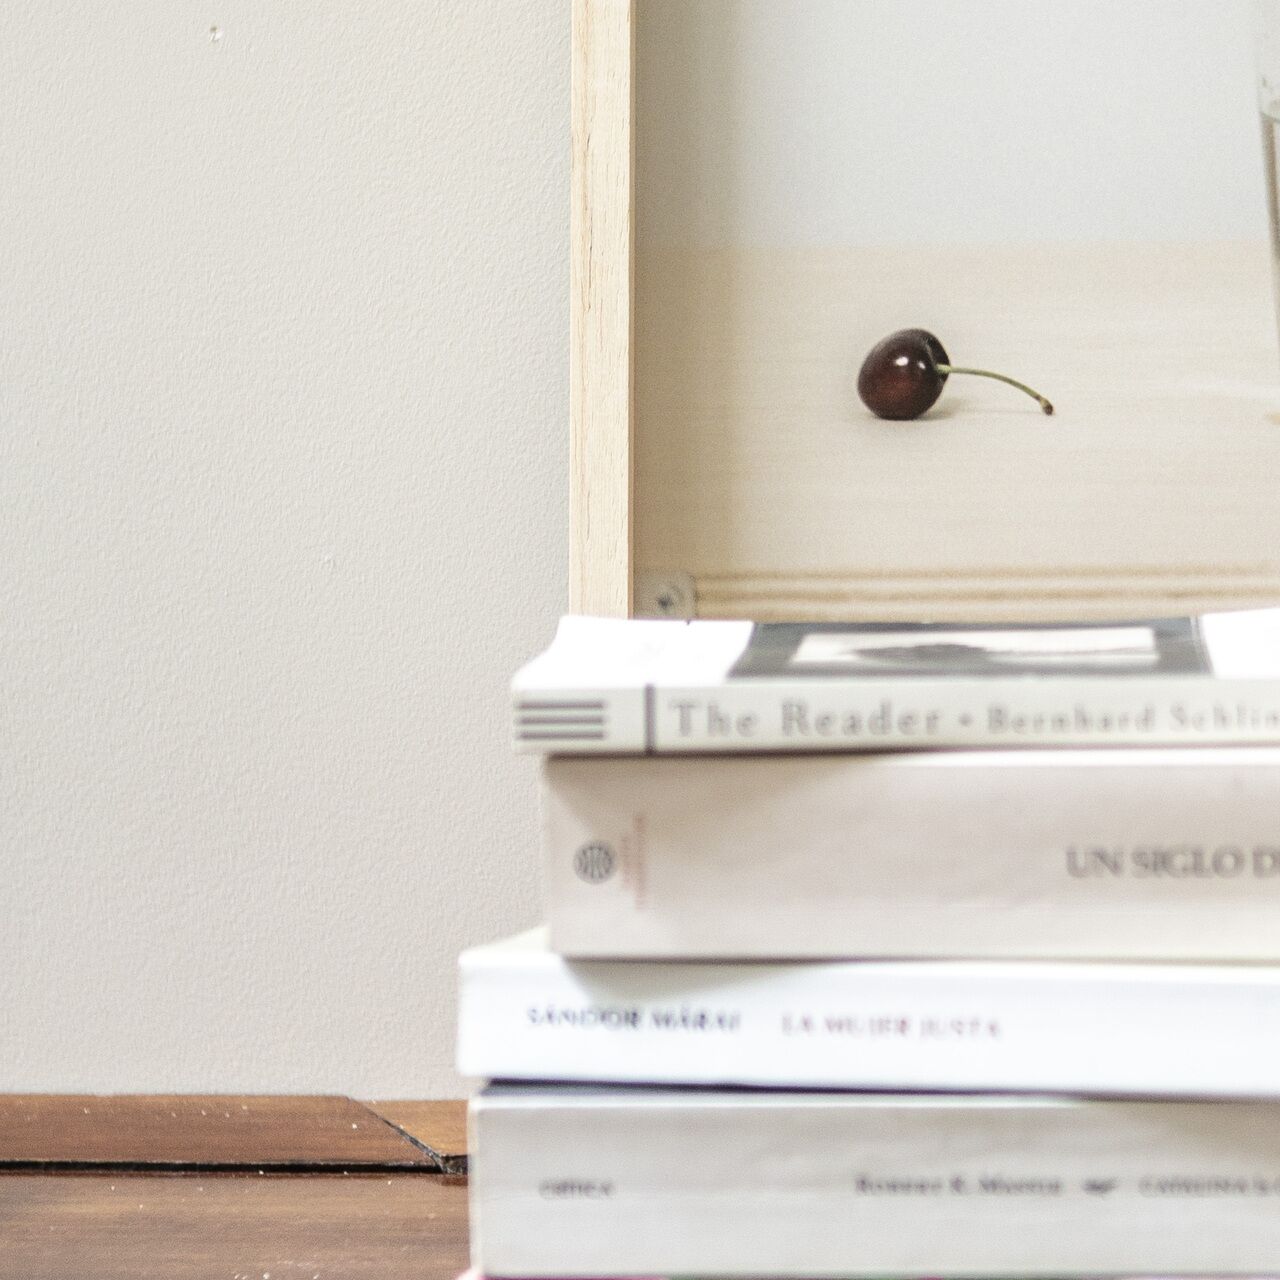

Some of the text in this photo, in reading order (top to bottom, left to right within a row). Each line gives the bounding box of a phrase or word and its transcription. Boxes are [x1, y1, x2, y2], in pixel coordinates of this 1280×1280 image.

[671, 698, 756, 738] The
[780, 697, 940, 736] Reader
[987, 702, 1152, 735] Bernhard
[1064, 845, 1123, 879] UN
[1131, 845, 1246, 879] SIGLO
[781, 1012, 816, 1037] LA
